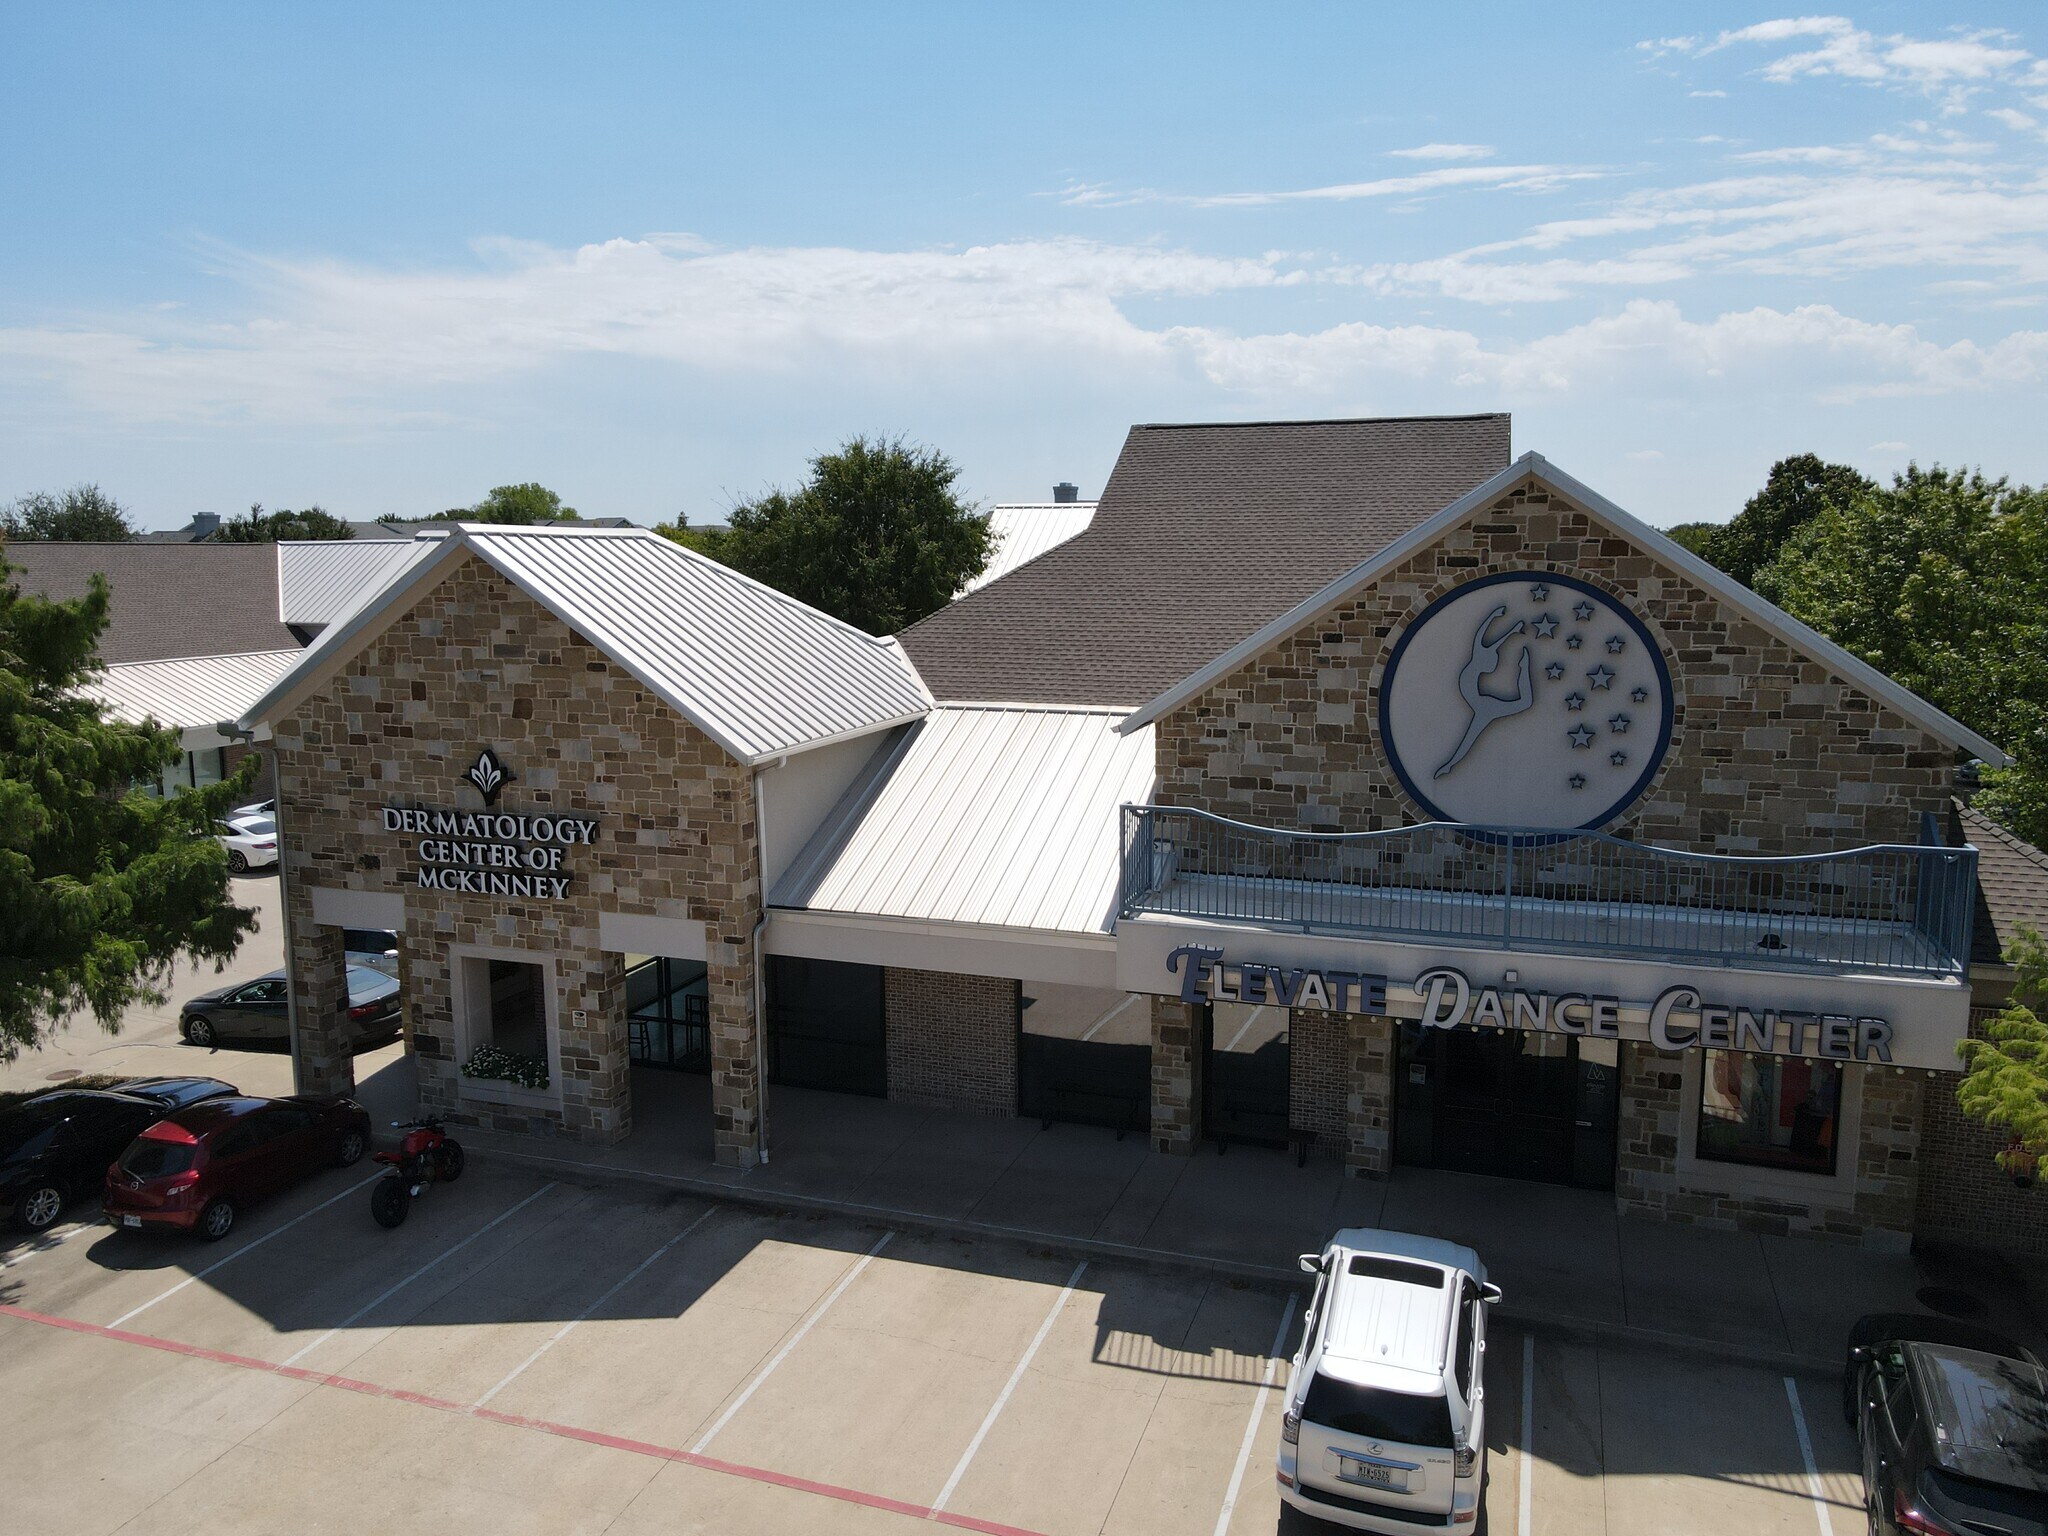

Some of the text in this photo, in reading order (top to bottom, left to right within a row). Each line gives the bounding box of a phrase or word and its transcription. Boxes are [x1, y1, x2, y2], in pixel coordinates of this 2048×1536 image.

[381, 807, 597, 845] DERMATOLOGY
[418, 839, 562, 871] CENTER OF
[417, 866, 570, 900] MCKINNEY
[1166, 943, 1894, 1062] ELEVATE DANCE CENTER
